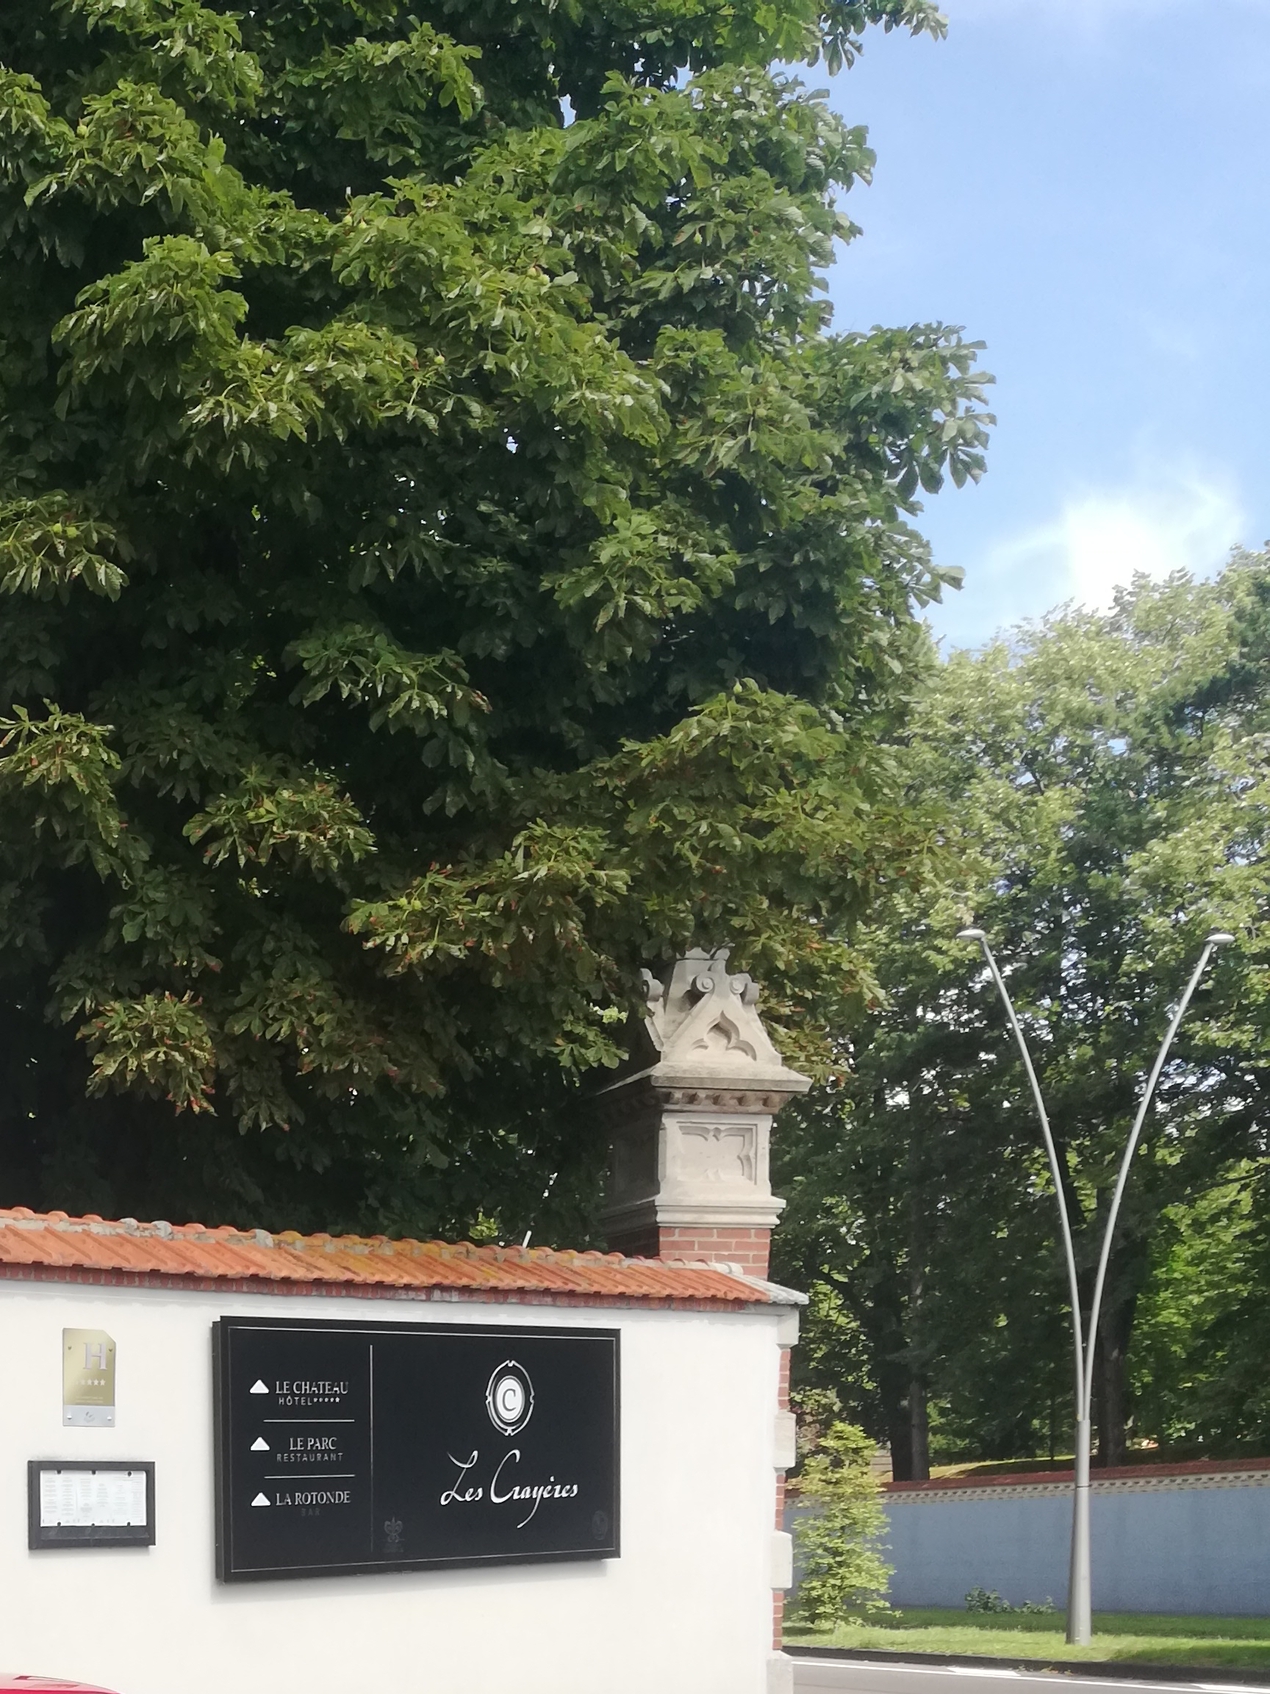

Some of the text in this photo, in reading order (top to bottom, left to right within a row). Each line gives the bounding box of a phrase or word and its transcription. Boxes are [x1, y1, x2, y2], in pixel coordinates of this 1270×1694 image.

[276, 1381, 349, 1394] LE CHATEAU
[289, 1436, 337, 1450] LE PARC
[276, 1452, 344, 1463] RESTAURANT
[440, 1449, 578, 1528] Les Crayères
[276, 1491, 351, 1506] LA ROTONDE
